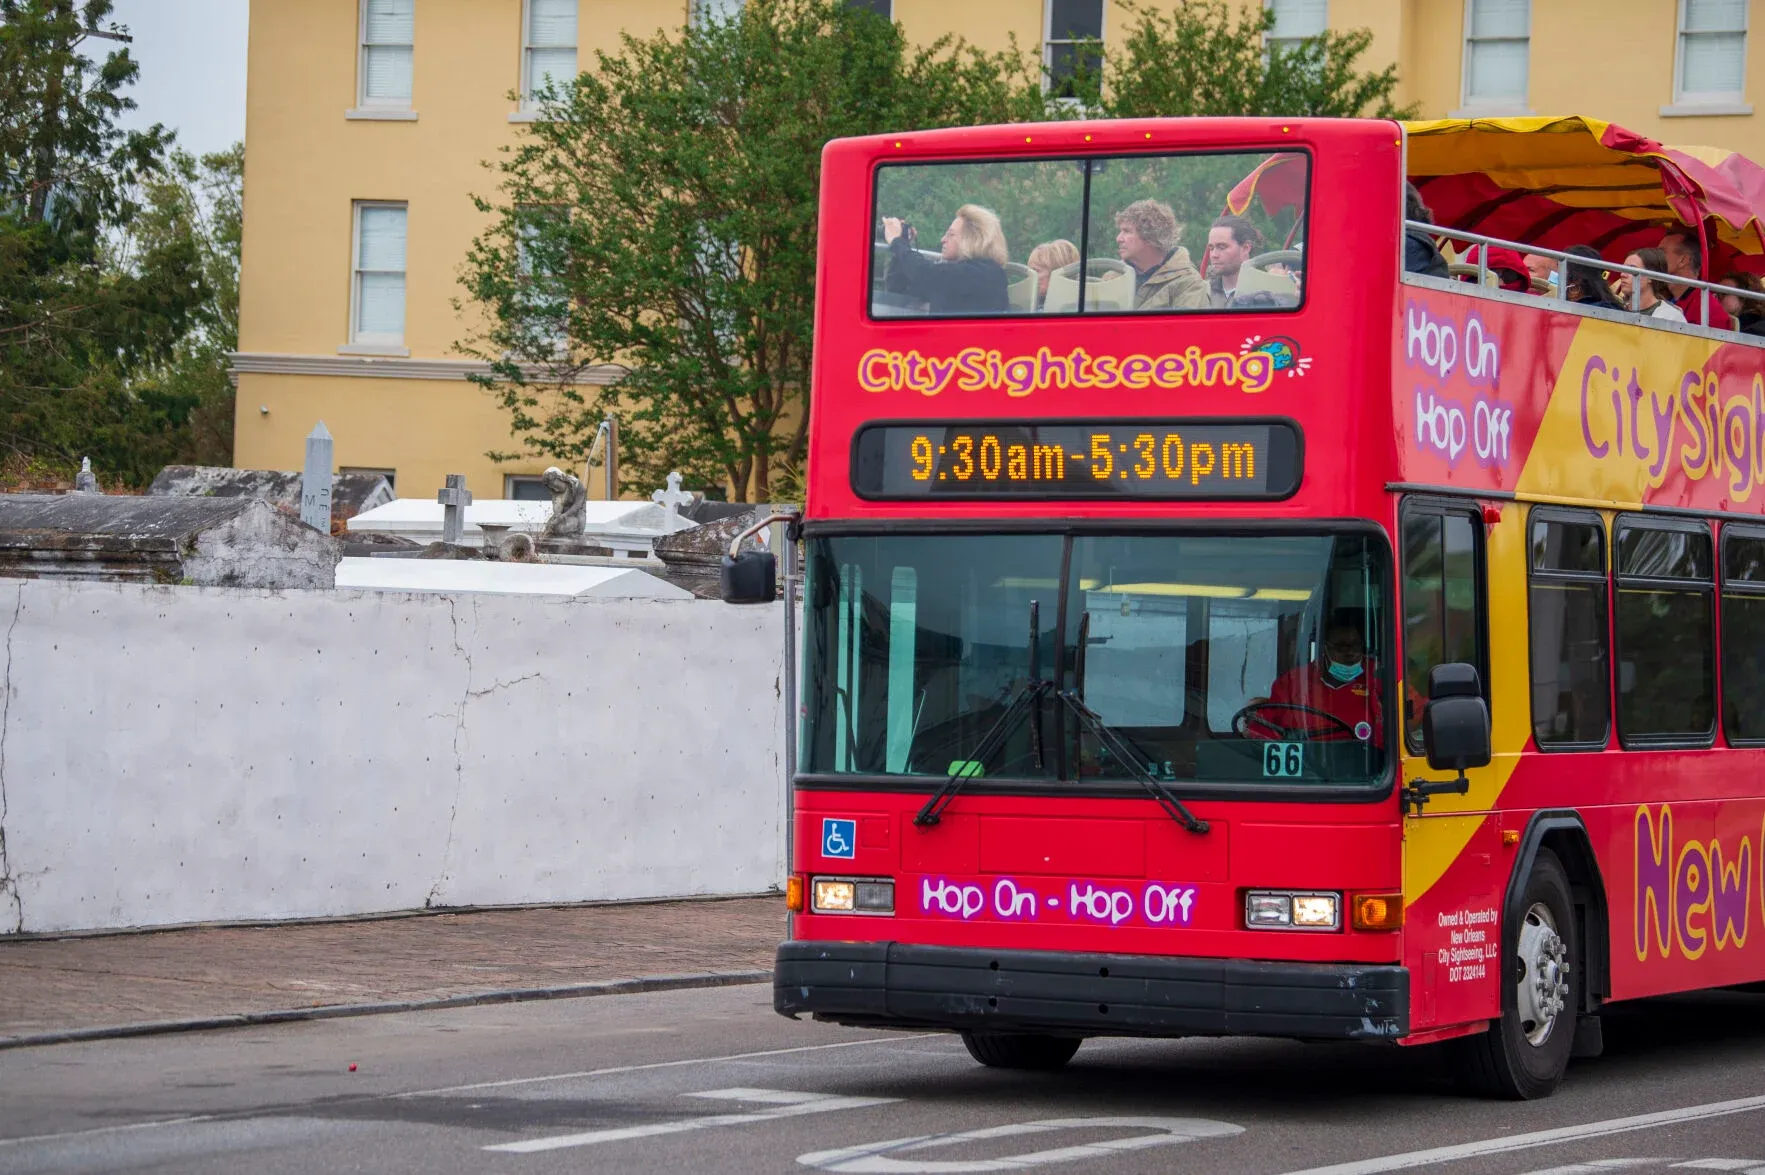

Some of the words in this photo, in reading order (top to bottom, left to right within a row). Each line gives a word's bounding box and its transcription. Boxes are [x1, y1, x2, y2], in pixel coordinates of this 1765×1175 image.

[1407, 307, 1458, 378] Hop
[1464, 317, 1498, 380] On
[858, 345, 1275, 397] CitySightseeing
[1416, 391, 1467, 461] Hop
[1473, 400, 1513, 461] Off
[1266, 743, 1300, 776] 66
[922, 878, 984, 919] Hop
[994, 879, 1036, 917] On
[1070, 883, 1133, 925] Hop
[1144, 884, 1196, 922] Off
[1634, 803, 1751, 962] New
[1438, 911, 1459, 927] Owned
[1459, 910, 1464, 925] &
[1464, 908, 1490, 928] Operated
[1490, 907, 1498, 926] by
[1450, 929, 1464, 945] New
[1464, 928, 1486, 943] Orleans
[1438, 948, 1450, 966] City
[1485, 943, 1497, 958] LLC
[1449, 967, 1463, 982] DOT
